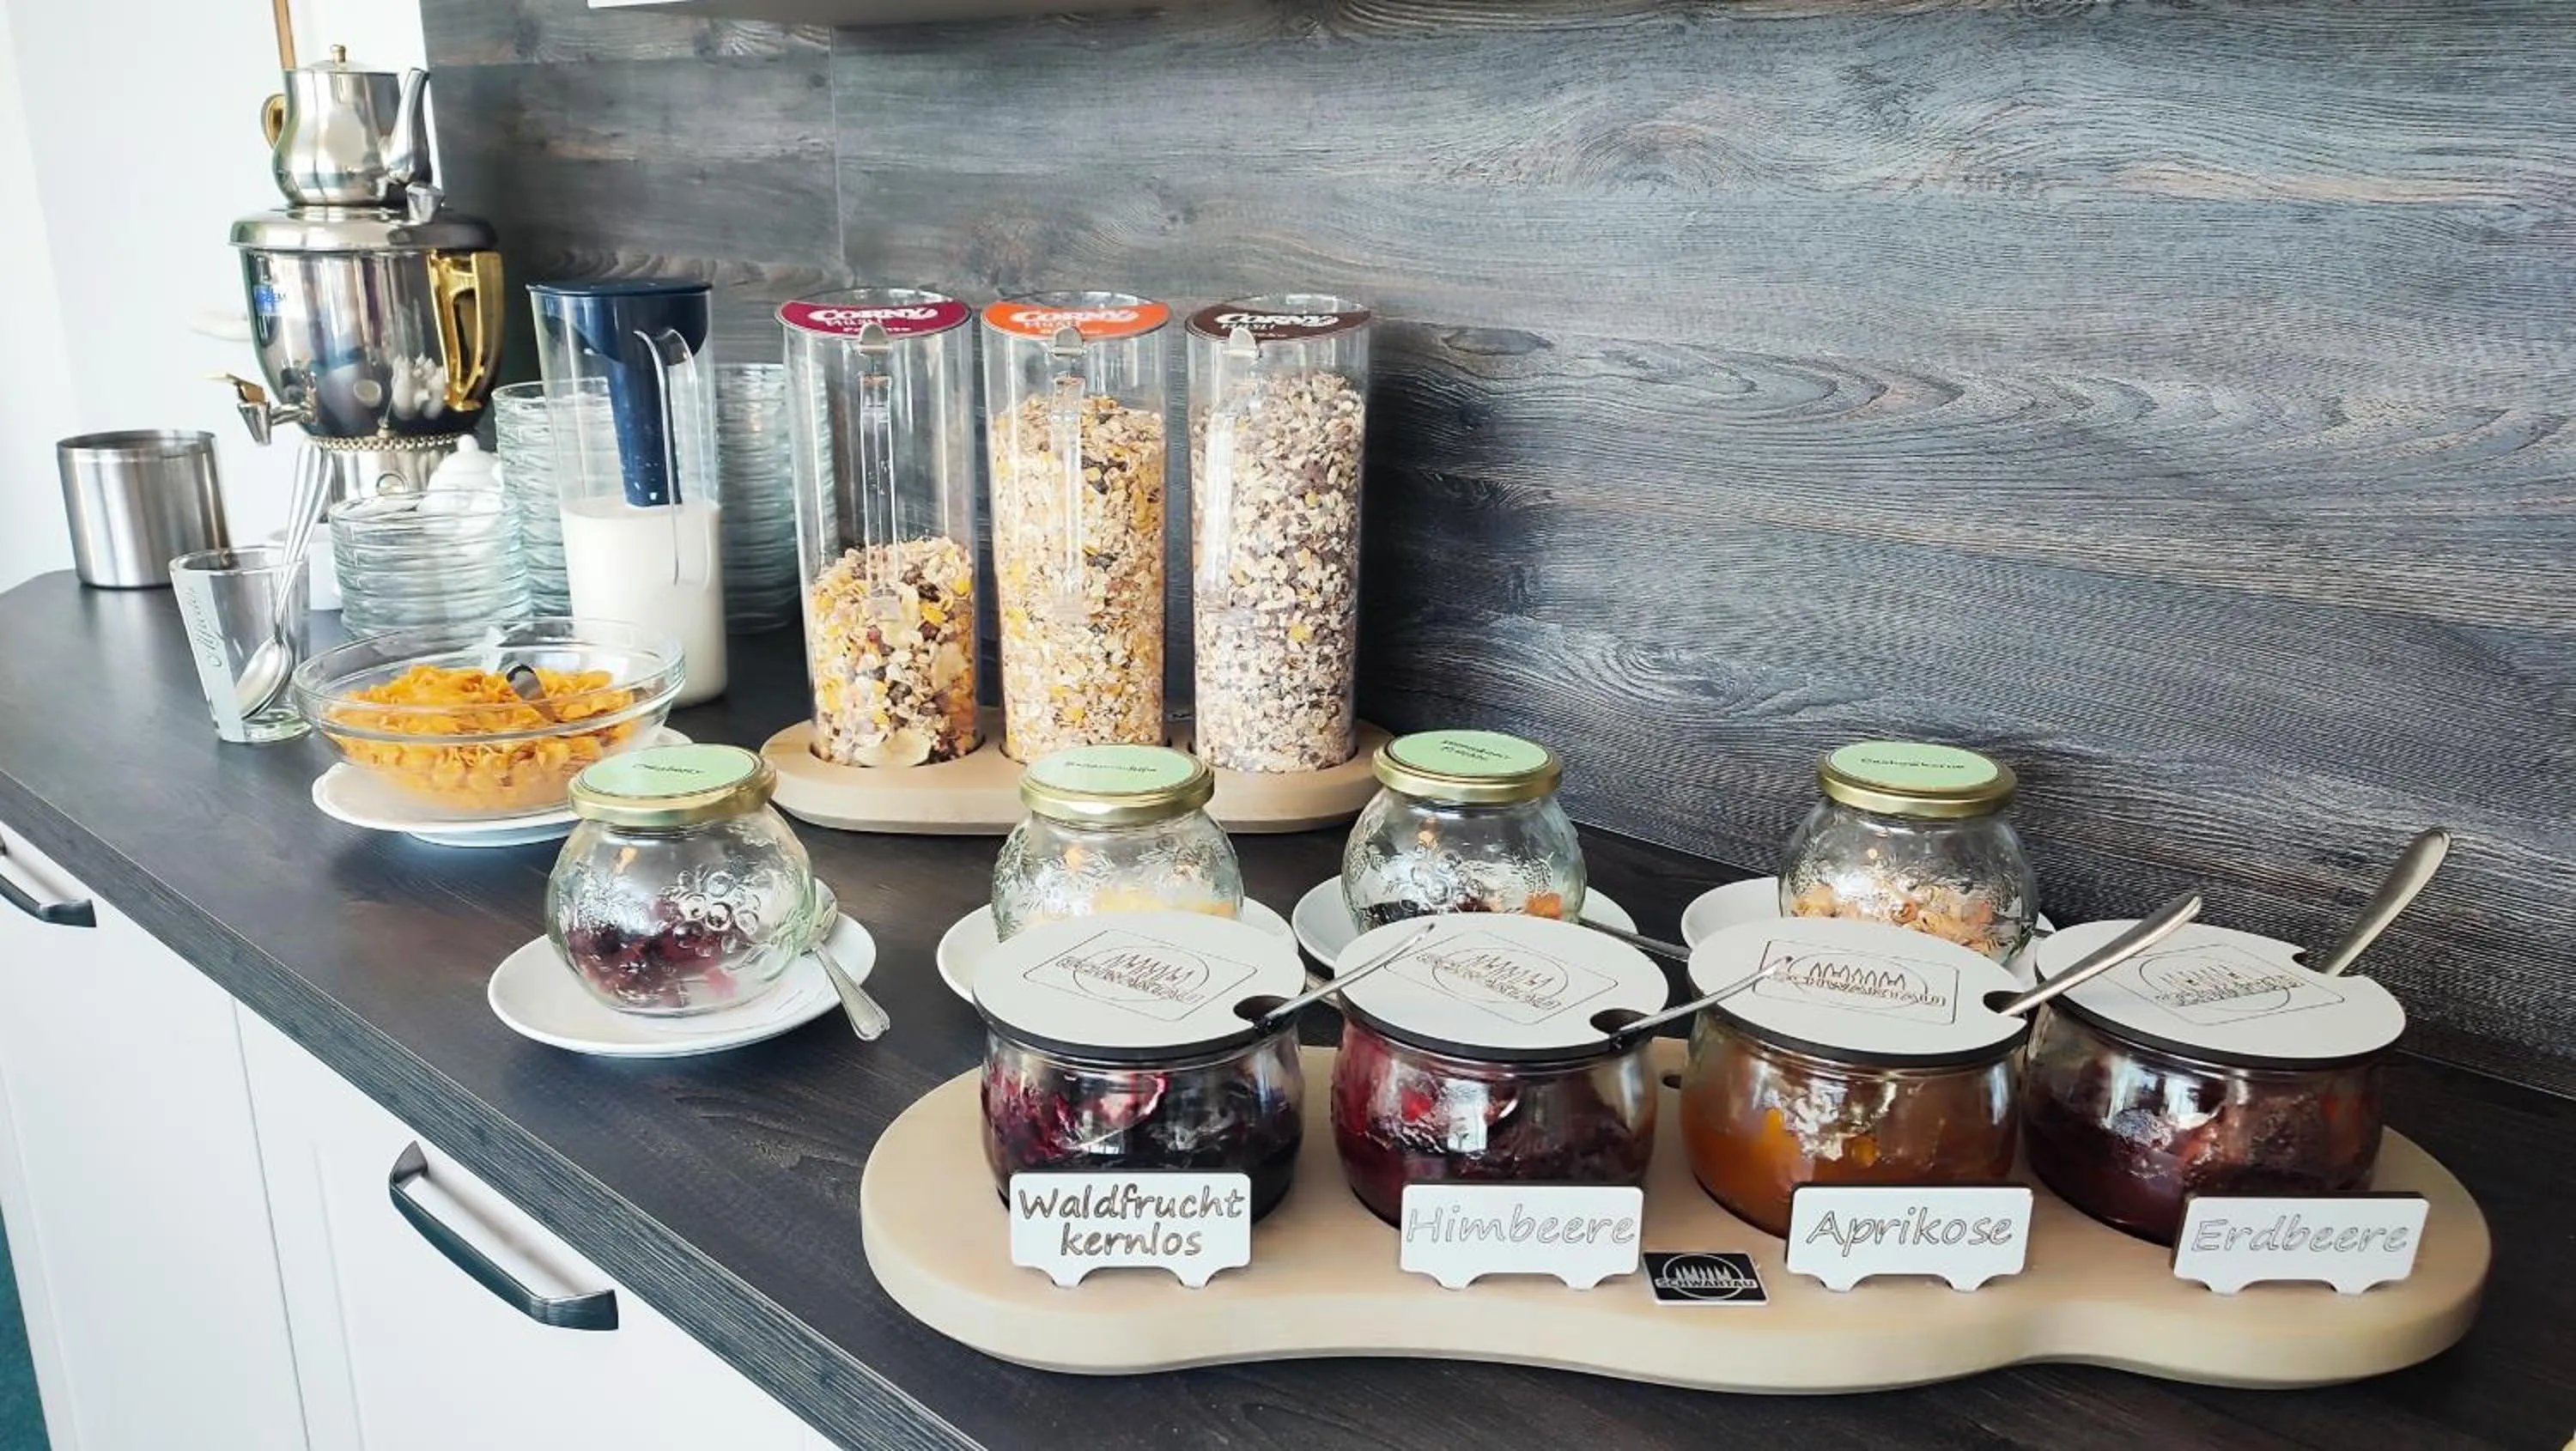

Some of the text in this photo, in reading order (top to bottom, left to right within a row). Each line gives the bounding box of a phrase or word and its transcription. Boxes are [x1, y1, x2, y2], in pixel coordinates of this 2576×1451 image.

[807, 307, 939, 321] CORNY
[1214, 313, 1340, 326] CORNY
[1018, 1183, 1243, 1221] Waldfrucht
[1061, 1223, 1202, 1257] kernlos
[1406, 1205, 1635, 1246] Himbeere
[1806, 1206, 2012, 1256] Aprikose
[2190, 1214, 2409, 1254] Erdbeere
[1657, 1278, 1754, 1288] SCHWARTAU
